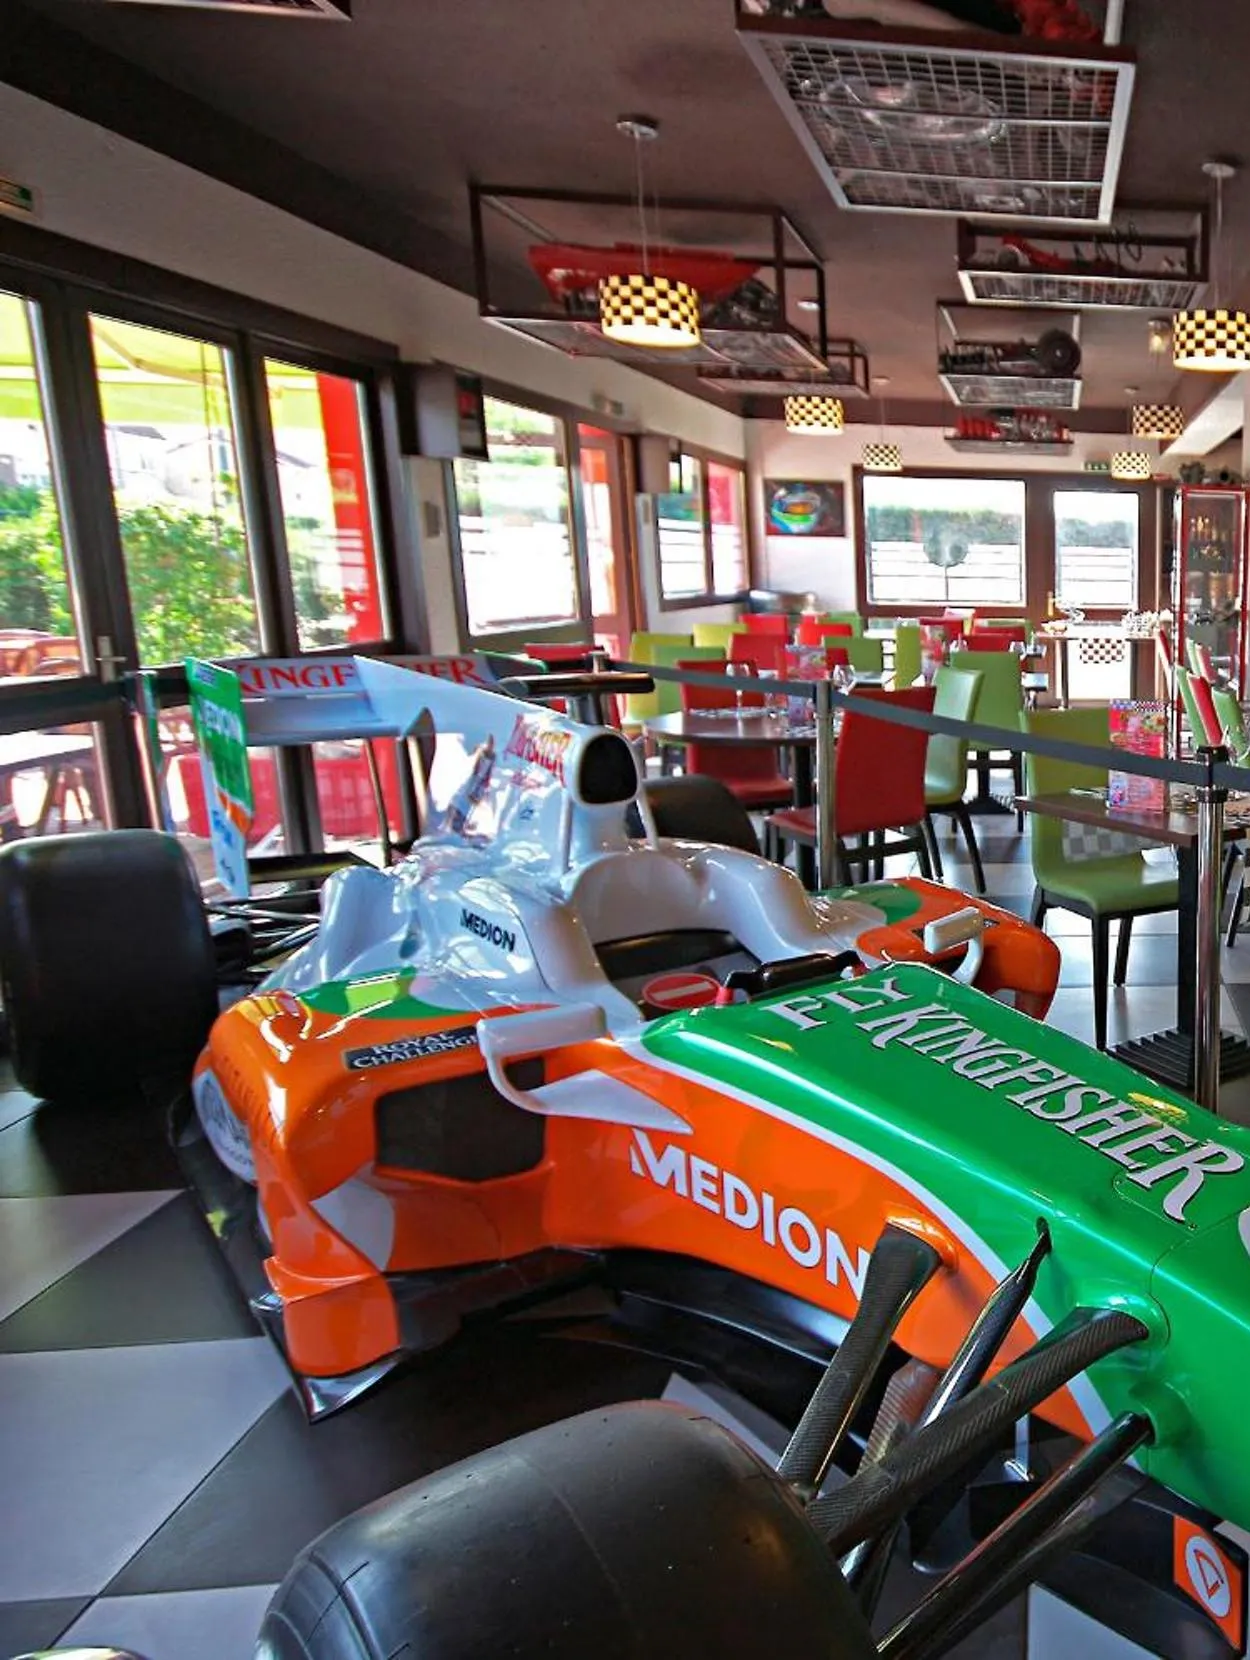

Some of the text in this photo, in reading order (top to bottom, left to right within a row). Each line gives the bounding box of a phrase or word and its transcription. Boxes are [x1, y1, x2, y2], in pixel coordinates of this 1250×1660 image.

[460, 908, 516, 953] MEDION
[759, 977, 914, 1031] FLY
[371, 1031, 452, 1056] ROYAL
[855, 1002, 1245, 1223] KINGFISHER
[629, 1128, 871, 1300] MEDION
